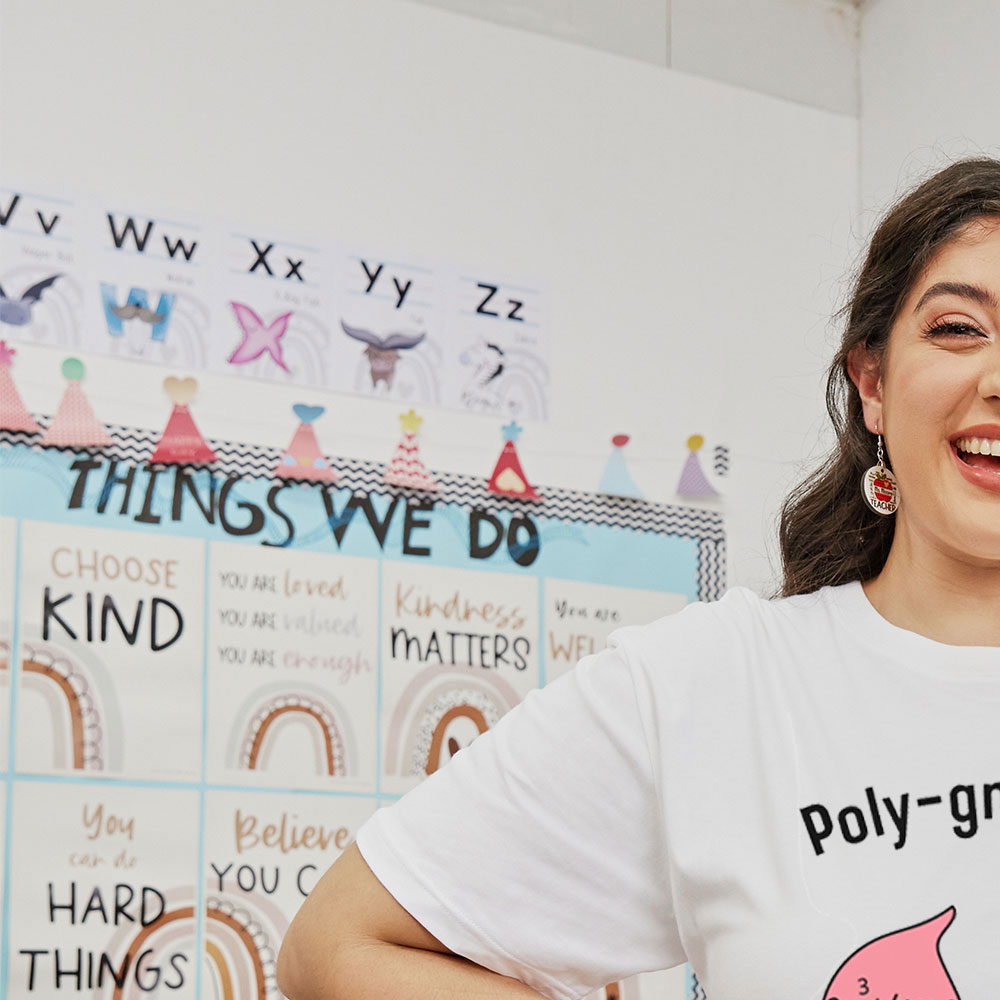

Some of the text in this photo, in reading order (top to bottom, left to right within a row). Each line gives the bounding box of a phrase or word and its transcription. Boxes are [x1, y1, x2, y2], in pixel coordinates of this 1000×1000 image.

[67, 457, 540, 567] THINGS WE DO
[51, 548, 180, 589] CHOOSE
[218, 568, 347, 601] YOU ARE loved
[42, 586, 184, 652] KIND
[218, 608, 248, 628] YOU
[252, 612, 277, 631] ARE
[395, 580, 527, 630] Kindness
[218, 645, 373, 686] YOU ARE enough
[82, 803, 135, 841] You
[234, 809, 353, 854] Believe
[68, 849, 137, 869] can do
[211, 863, 279, 894] YOU
[48, 882, 165, 928] HARD
[19, 947, 188, 992] THINGS
